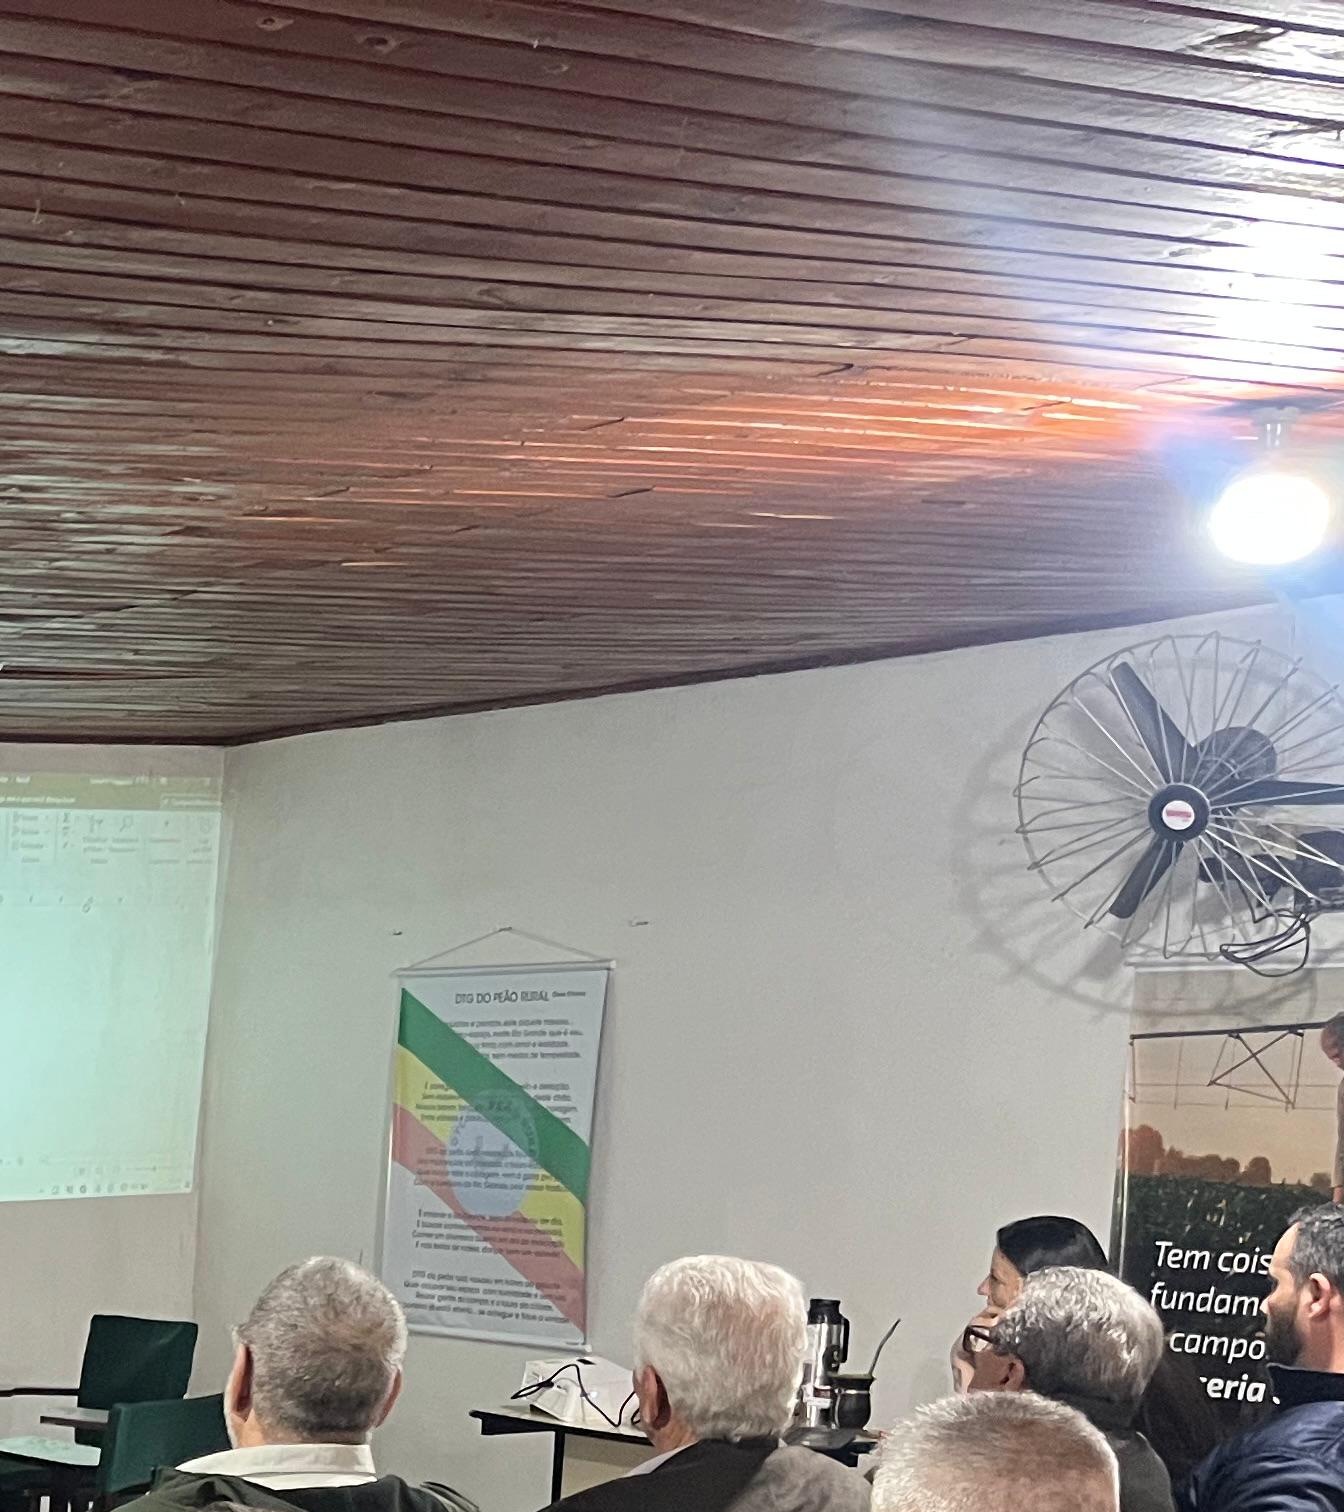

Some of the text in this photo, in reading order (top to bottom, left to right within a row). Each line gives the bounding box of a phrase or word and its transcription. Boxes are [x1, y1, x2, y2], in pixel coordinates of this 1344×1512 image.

[476, 992, 491, 1003] DO
[1155, 1241, 1210, 1270] Tem
[1169, 1332, 1266, 1365] campo
[1199, 1373, 1267, 1404] eria
